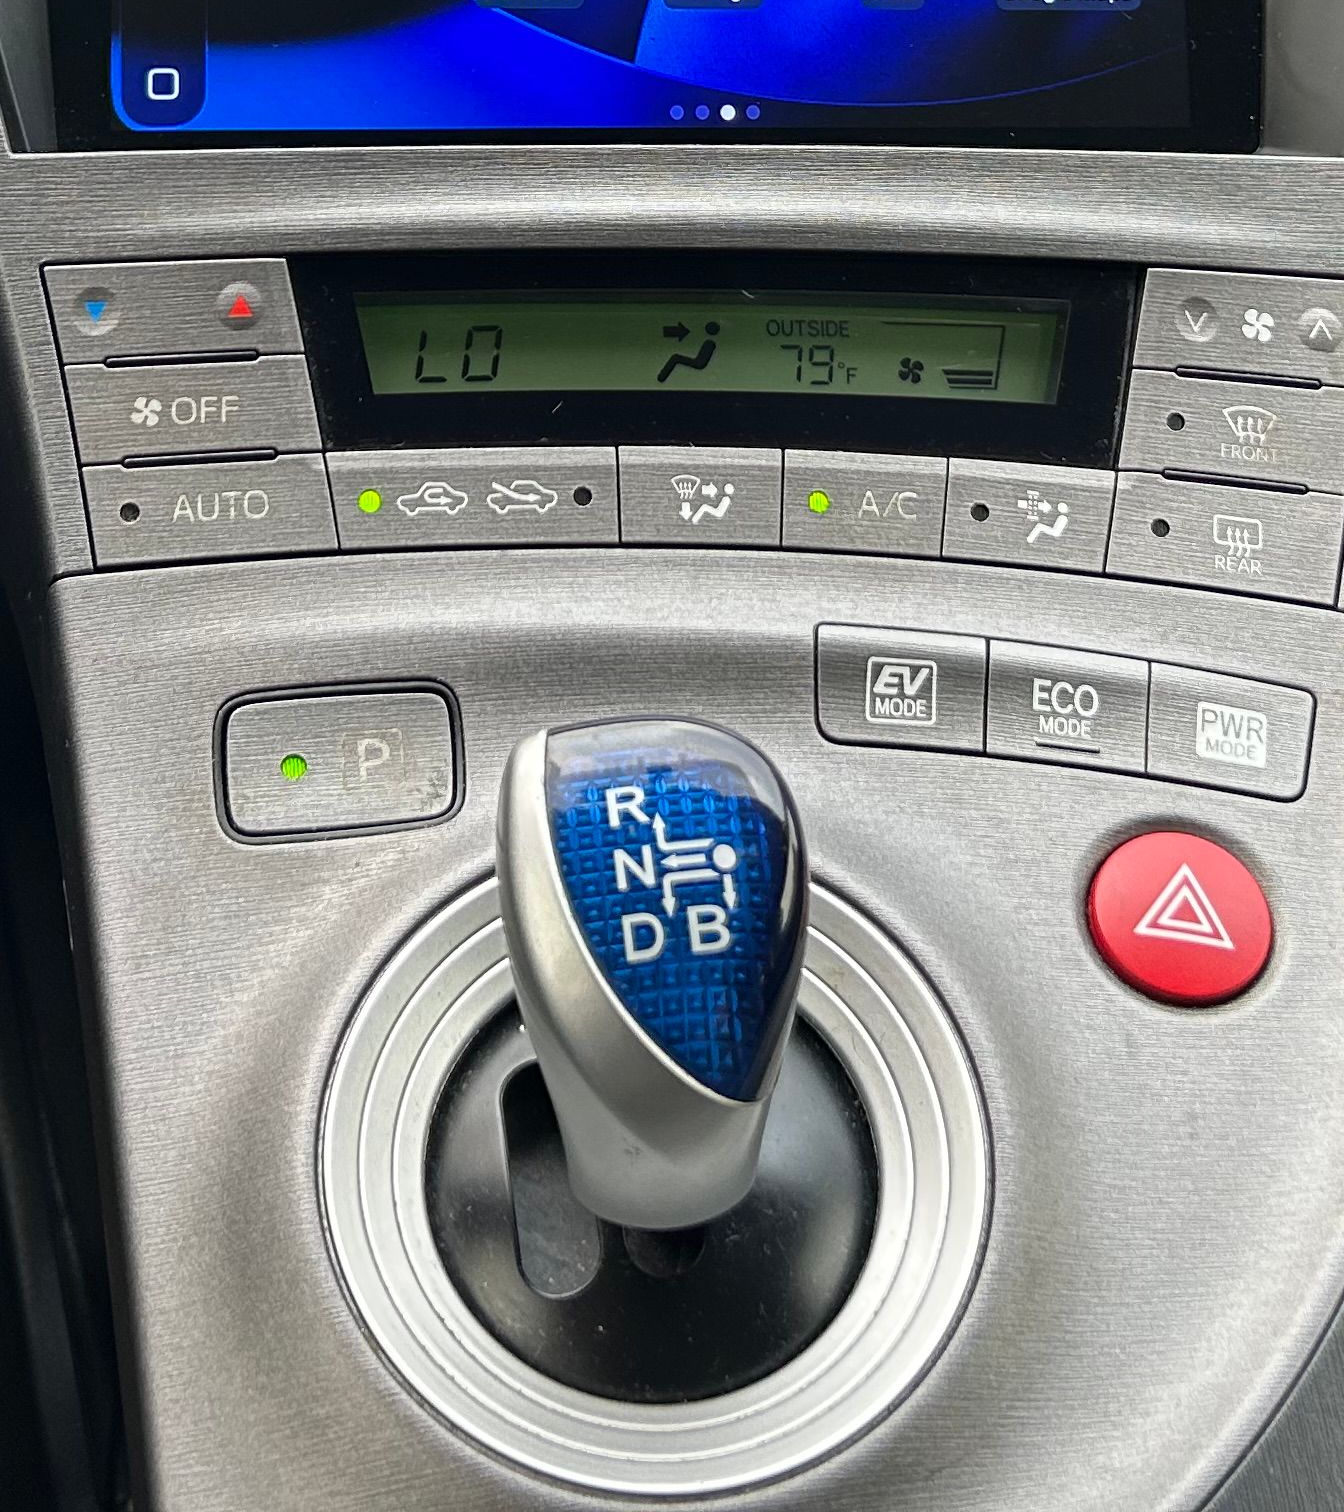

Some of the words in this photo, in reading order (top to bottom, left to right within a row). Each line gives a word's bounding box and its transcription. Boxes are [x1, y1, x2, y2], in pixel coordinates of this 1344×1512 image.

[766, 319, 850, 338] OUTSIDE
[171, 396, 239, 425] OFF
[1220, 443, 1277, 463] FRONT
[172, 489, 270, 523] AUTO
[858, 490, 919, 520] A/C
[1214, 555, 1263, 575] REAR
[872, 665, 929, 696] EV
[875, 696, 928, 718] MODE
[1032, 678, 1099, 718] ECO
[1039, 717, 1092, 737] MODE
[1201, 707, 1265, 743] PWR
[357, 739, 390, 783] P
[1205, 738, 1257, 760] MODE
[606, 786, 650, 828] R
[614, 845, 657, 892] N
[621, 913, 665, 963] D
[688, 905, 732, 955] B
